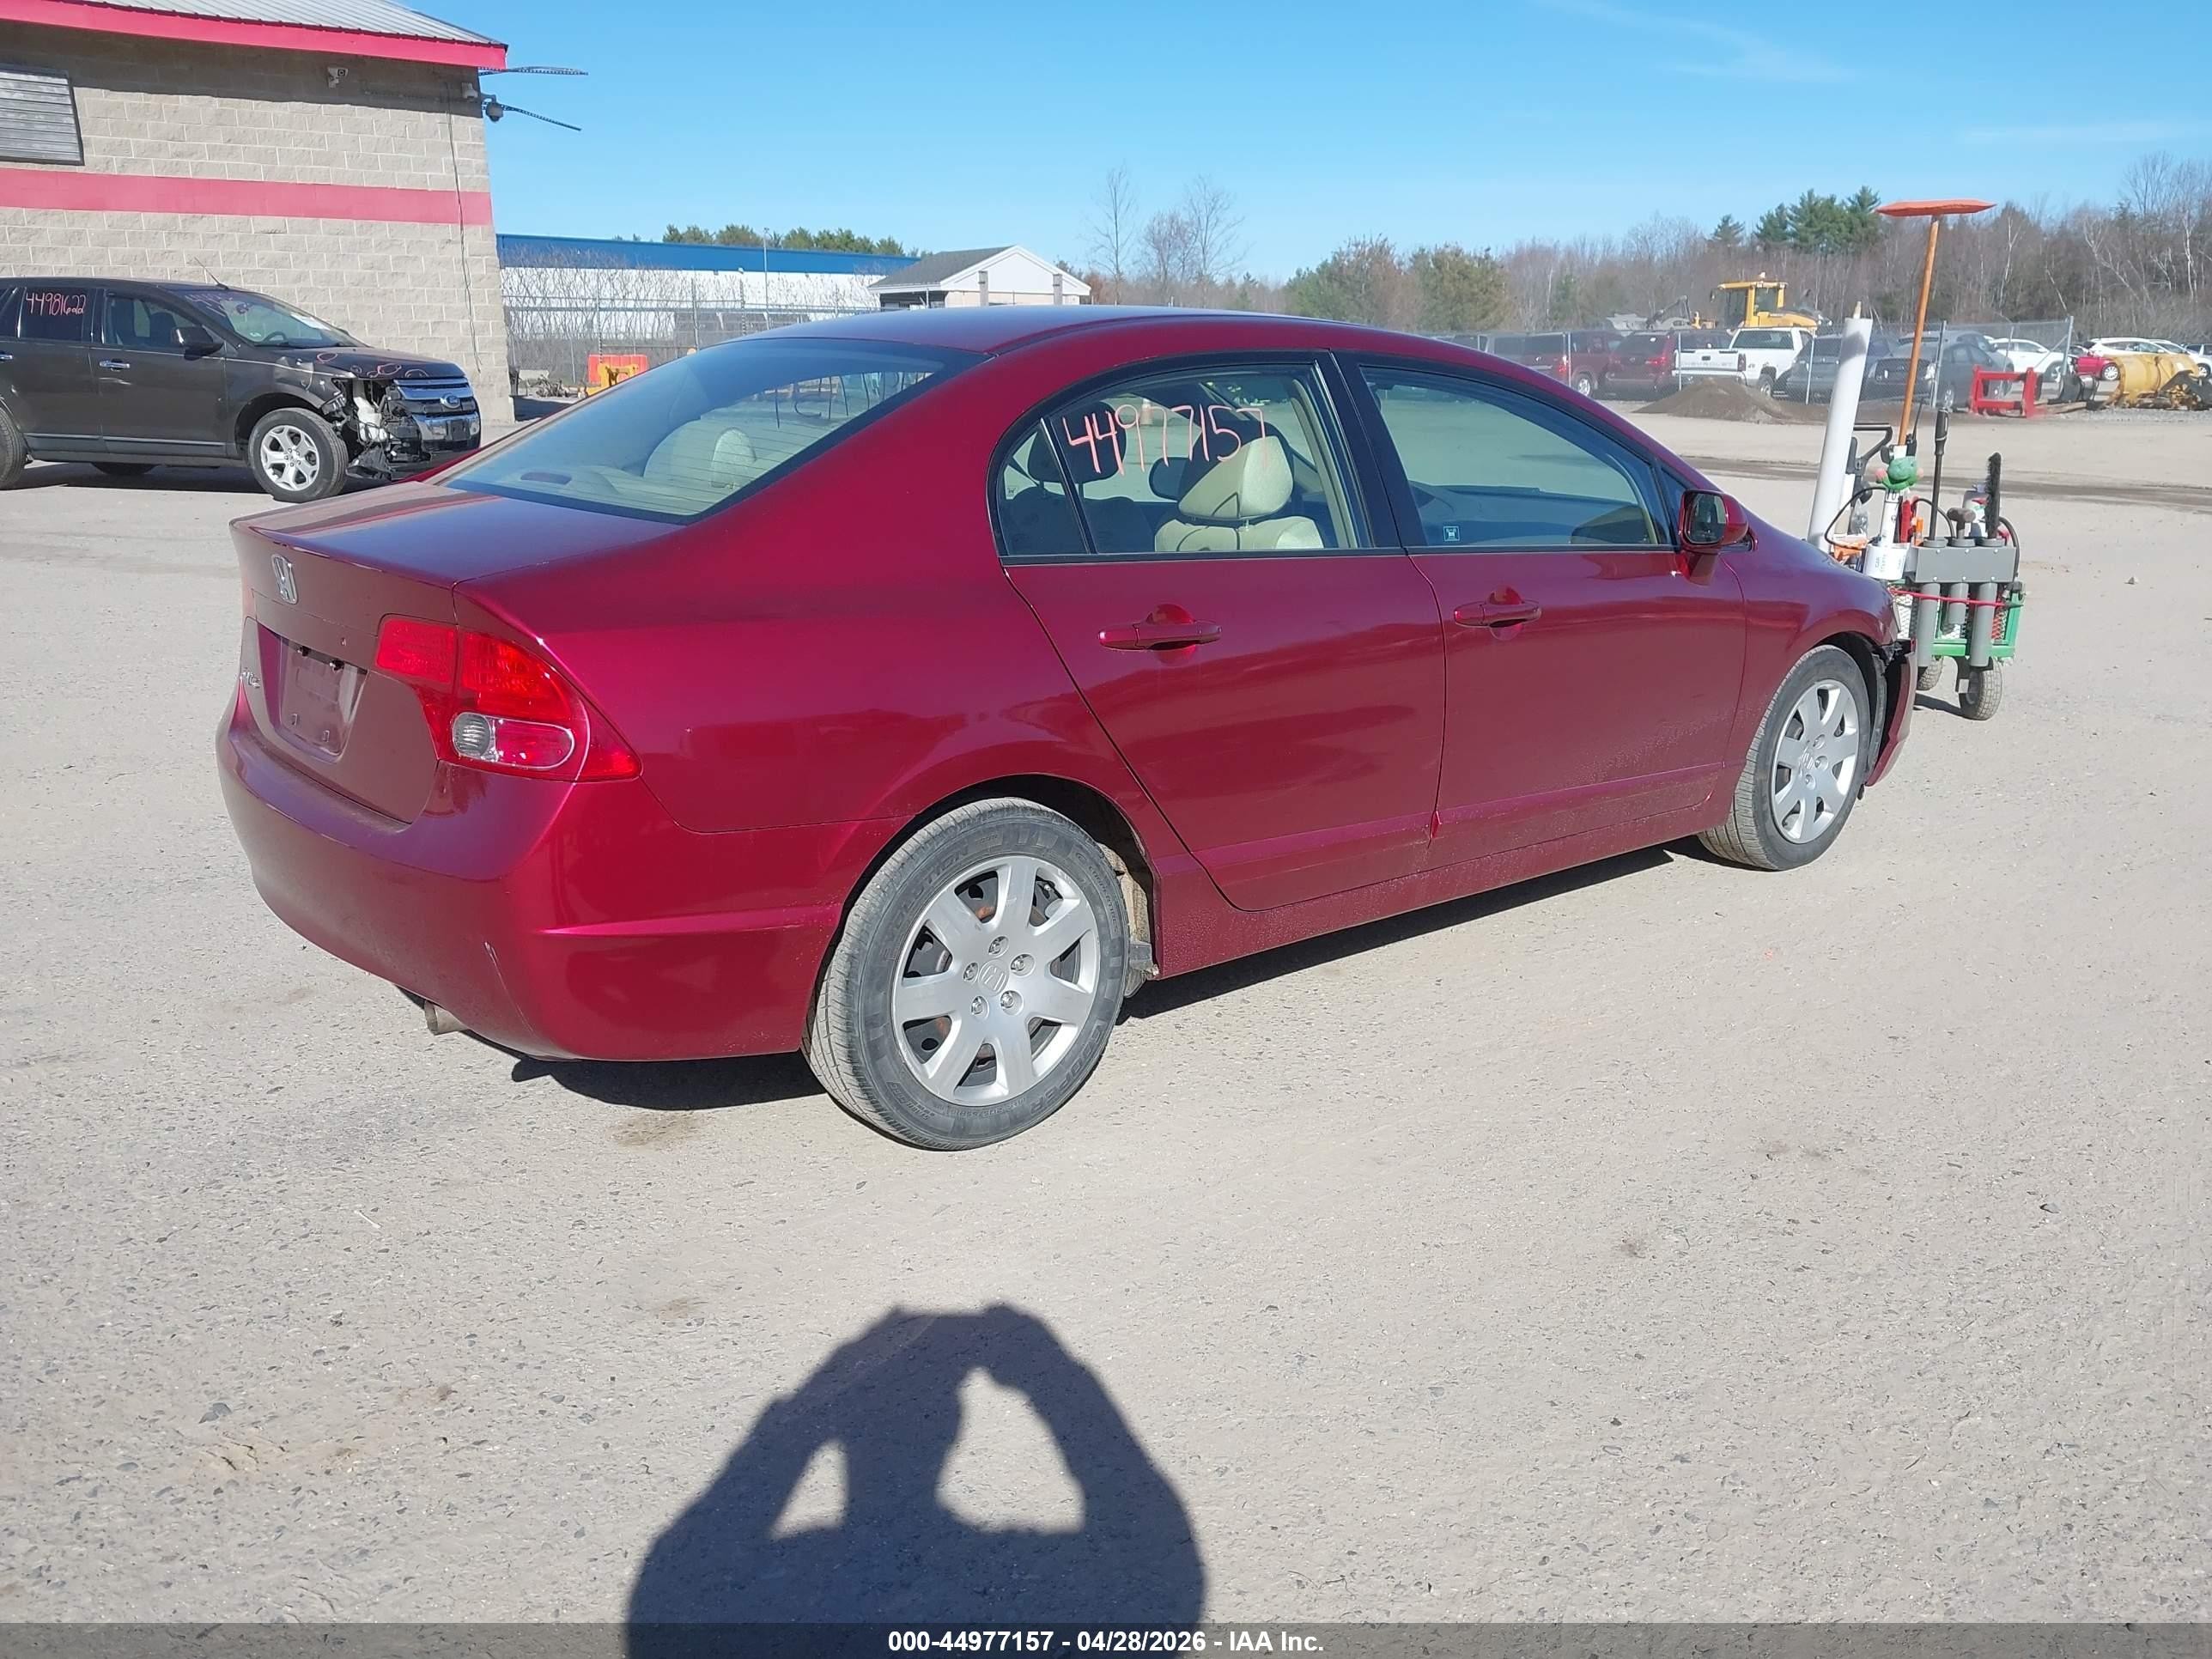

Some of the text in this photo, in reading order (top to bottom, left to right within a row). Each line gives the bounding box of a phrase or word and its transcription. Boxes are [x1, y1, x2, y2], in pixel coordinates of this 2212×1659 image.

[25, 292, 87, 316] 44981622
[1062, 404, 1267, 476] 44977157
[1030, 1020, 1106, 1115] COOPER
